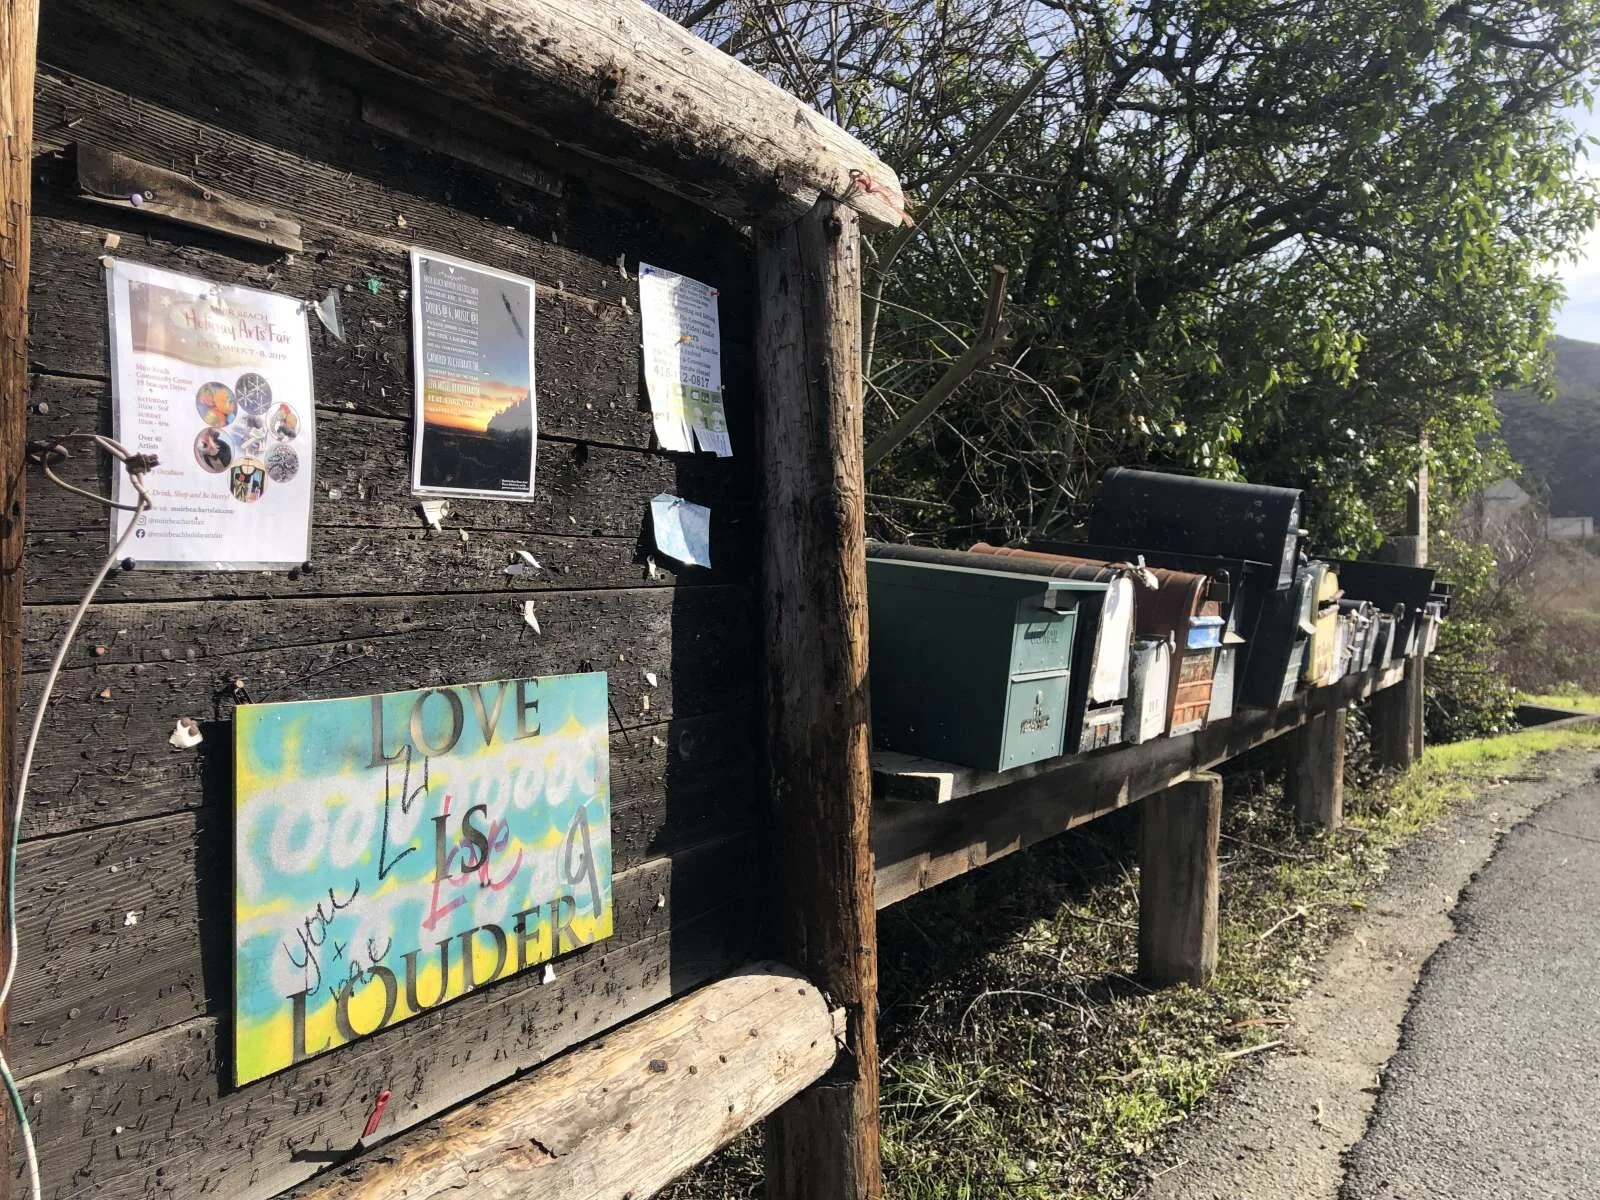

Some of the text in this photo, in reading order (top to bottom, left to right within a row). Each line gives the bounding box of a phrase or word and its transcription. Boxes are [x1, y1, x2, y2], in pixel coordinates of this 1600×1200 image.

[239, 318, 267, 342] Arts
[267, 322, 292, 345] Fair
[366, 678, 541, 769] LOVE
[431, 803, 489, 882] IS
